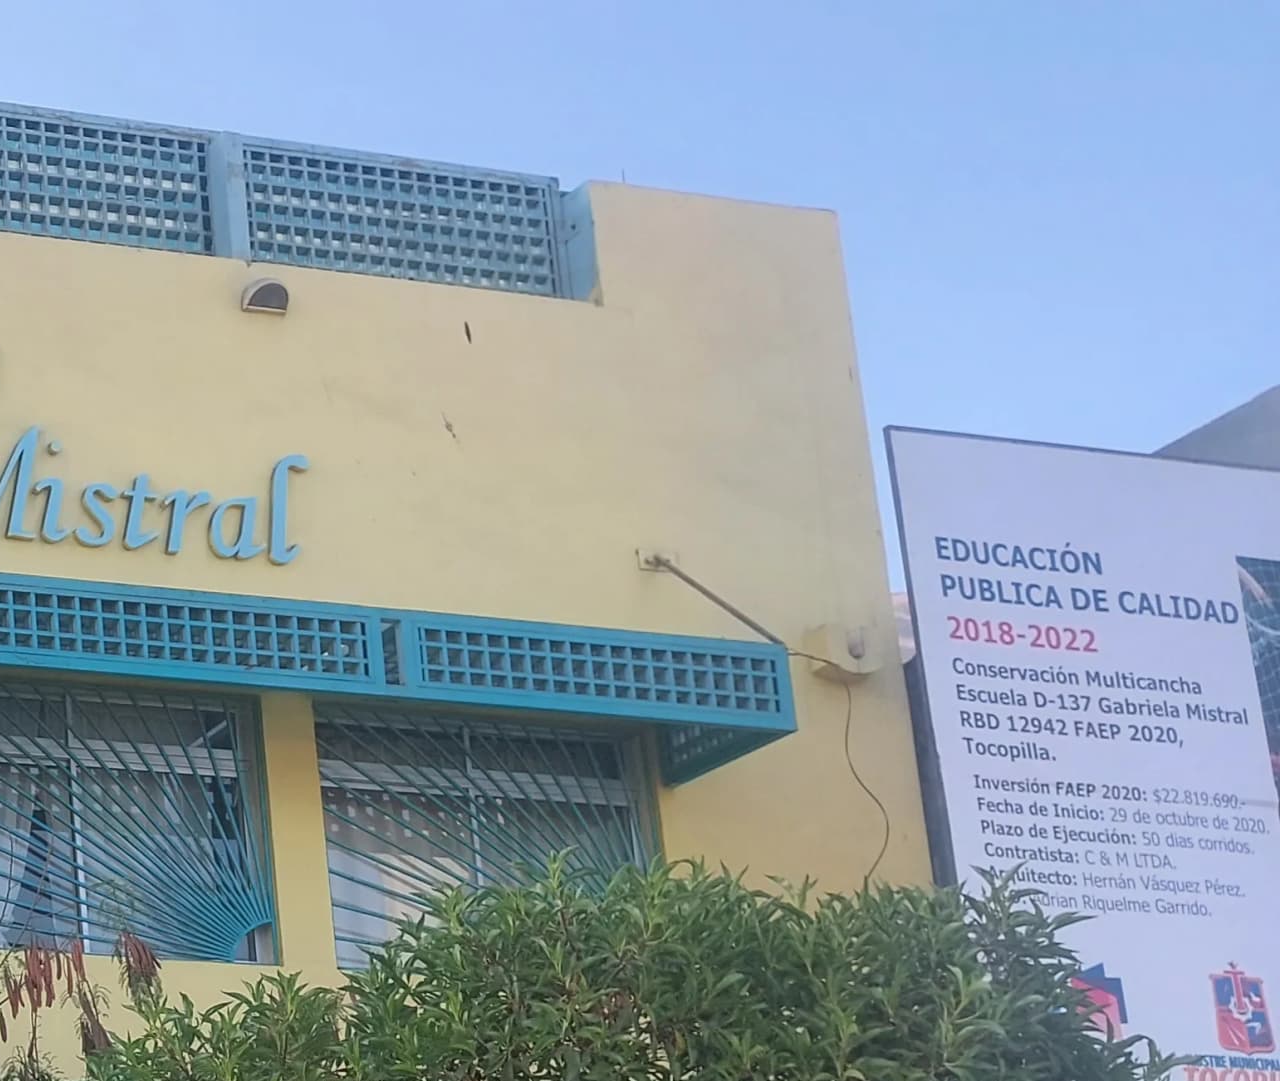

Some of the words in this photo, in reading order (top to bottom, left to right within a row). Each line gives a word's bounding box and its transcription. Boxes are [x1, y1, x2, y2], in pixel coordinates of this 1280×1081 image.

[934, 536, 1103, 575] EDUCACIÓN
[940, 574, 1063, 609] PUBLICA
[1070, 587, 1109, 612] DE
[1118, 591, 1239, 624] CALIDAD
[946, 616, 1099, 653] 2018-2022
[952, 657, 1080, 686] Conservación
[1085, 670, 1202, 695] Multicancha
[956, 684, 1027, 707] Escuela
[1033, 691, 1091, 712] D-137
[1098, 697, 1180, 719] Gabriela
[1186, 703, 1248, 725] Mistral
[960, 710, 1000, 730] RBD
[1006, 715, 1068, 736] 12942
[1074, 721, 1121, 740] FAEP
[1127, 724, 1183, 749] 2020,
[961, 737, 1057, 762] Tocopilla.
[973, 774, 1050, 795] Inversión
[1056, 781, 1096, 798] FAEP
[1102, 785, 1148, 802] 2020:
[976, 797, 1024, 815] Fecha
[1028, 801, 1049, 817] de
[1052, 803, 1105, 821] Inicio:
[1109, 807, 1127, 823] 29
[1133, 809, 1151, 824] de
[1155, 811, 1209, 829] octubre
[1212, 815, 1229, 831] de
[1233, 816, 1270, 835] 2020.
[981, 819, 1024, 837] Plazo
[1028, 823, 1049, 839] de
[1052, 825, 1137, 845] Ejecución:
[1142, 831, 1160, 847] 50
[1198, 837, 1255, 855] corridos.
[984, 842, 1080, 864] Contratista:
[1085, 850, 1096, 865] C
[1100, 851, 1111, 866] &
[1116, 851, 1128, 867] M
[1134, 853, 1177, 870] LTDA.
[1082, 871, 1136, 889] Hernán
[1140, 874, 1201, 895] Vásquez
[1204, 878, 1246, 897] Pérez.
[1081, 893, 1151, 914] Riquelme
[1155, 898, 1212, 917] Garrido.
